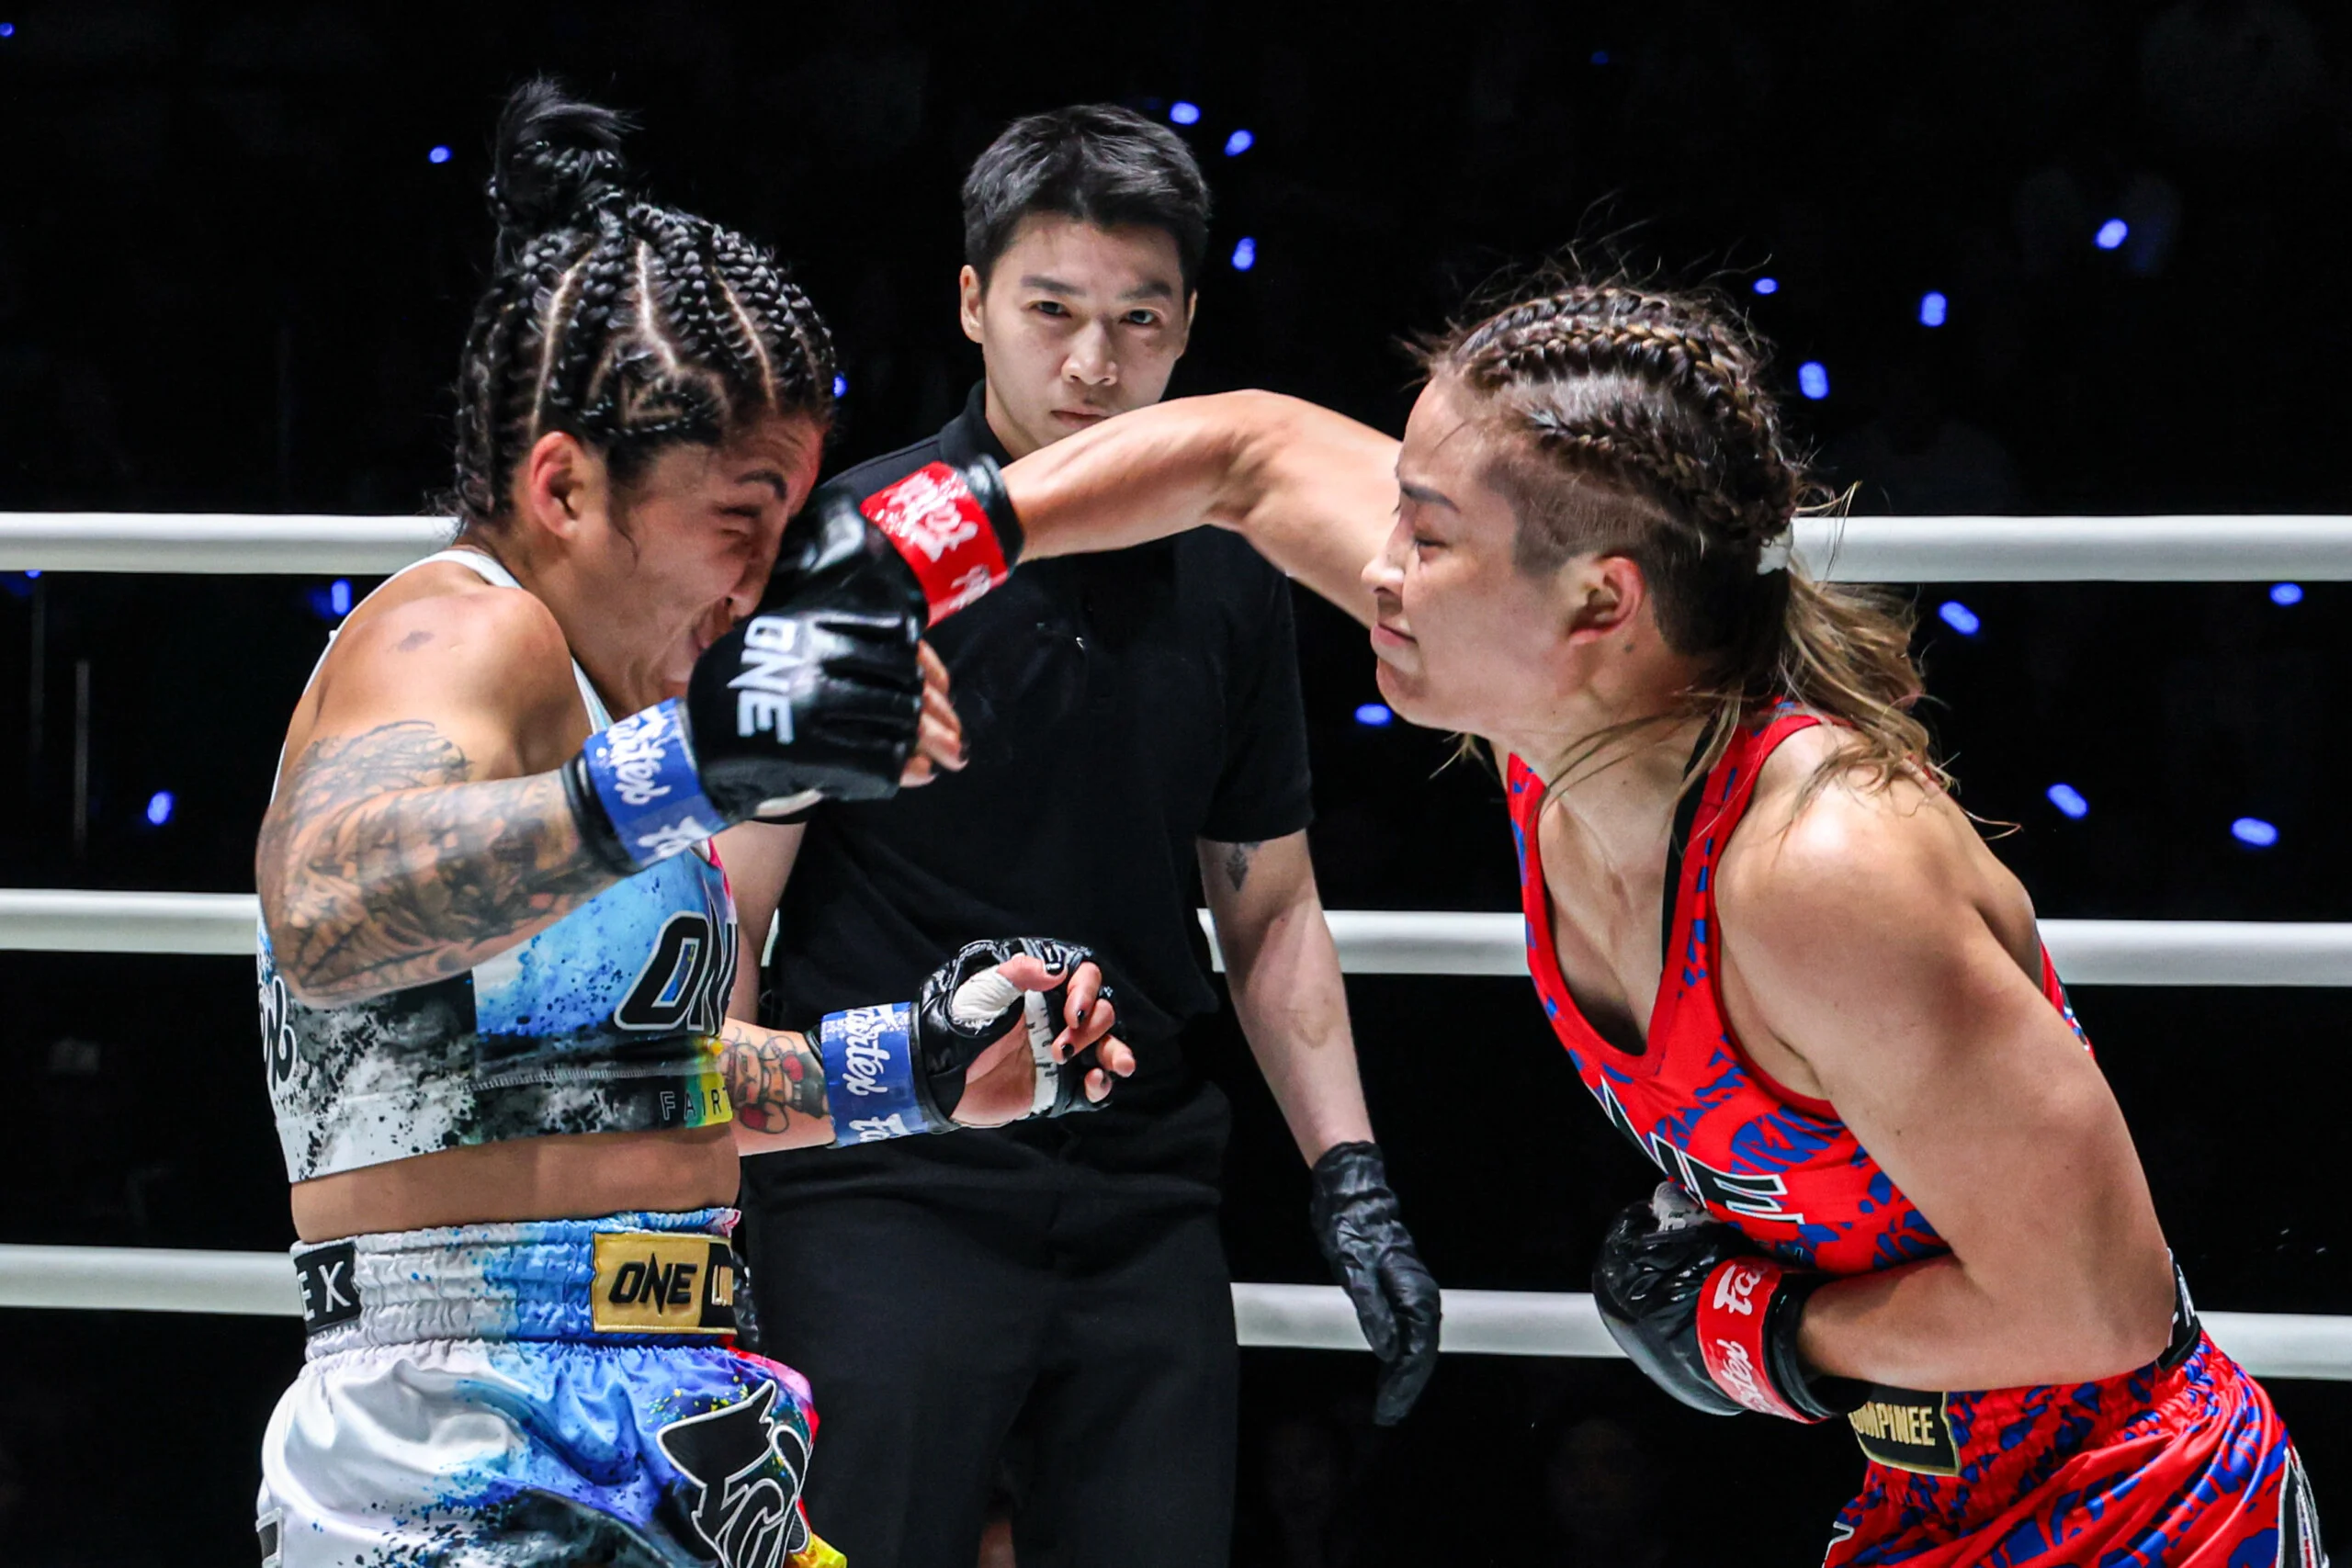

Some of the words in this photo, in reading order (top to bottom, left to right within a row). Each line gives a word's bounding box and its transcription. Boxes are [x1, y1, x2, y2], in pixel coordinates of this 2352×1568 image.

[726, 615, 803, 745] ONE
[614, 896, 739, 1036] ON
[660, 1086, 727, 1121] FAIR
[609, 1252, 698, 1315] ONE
